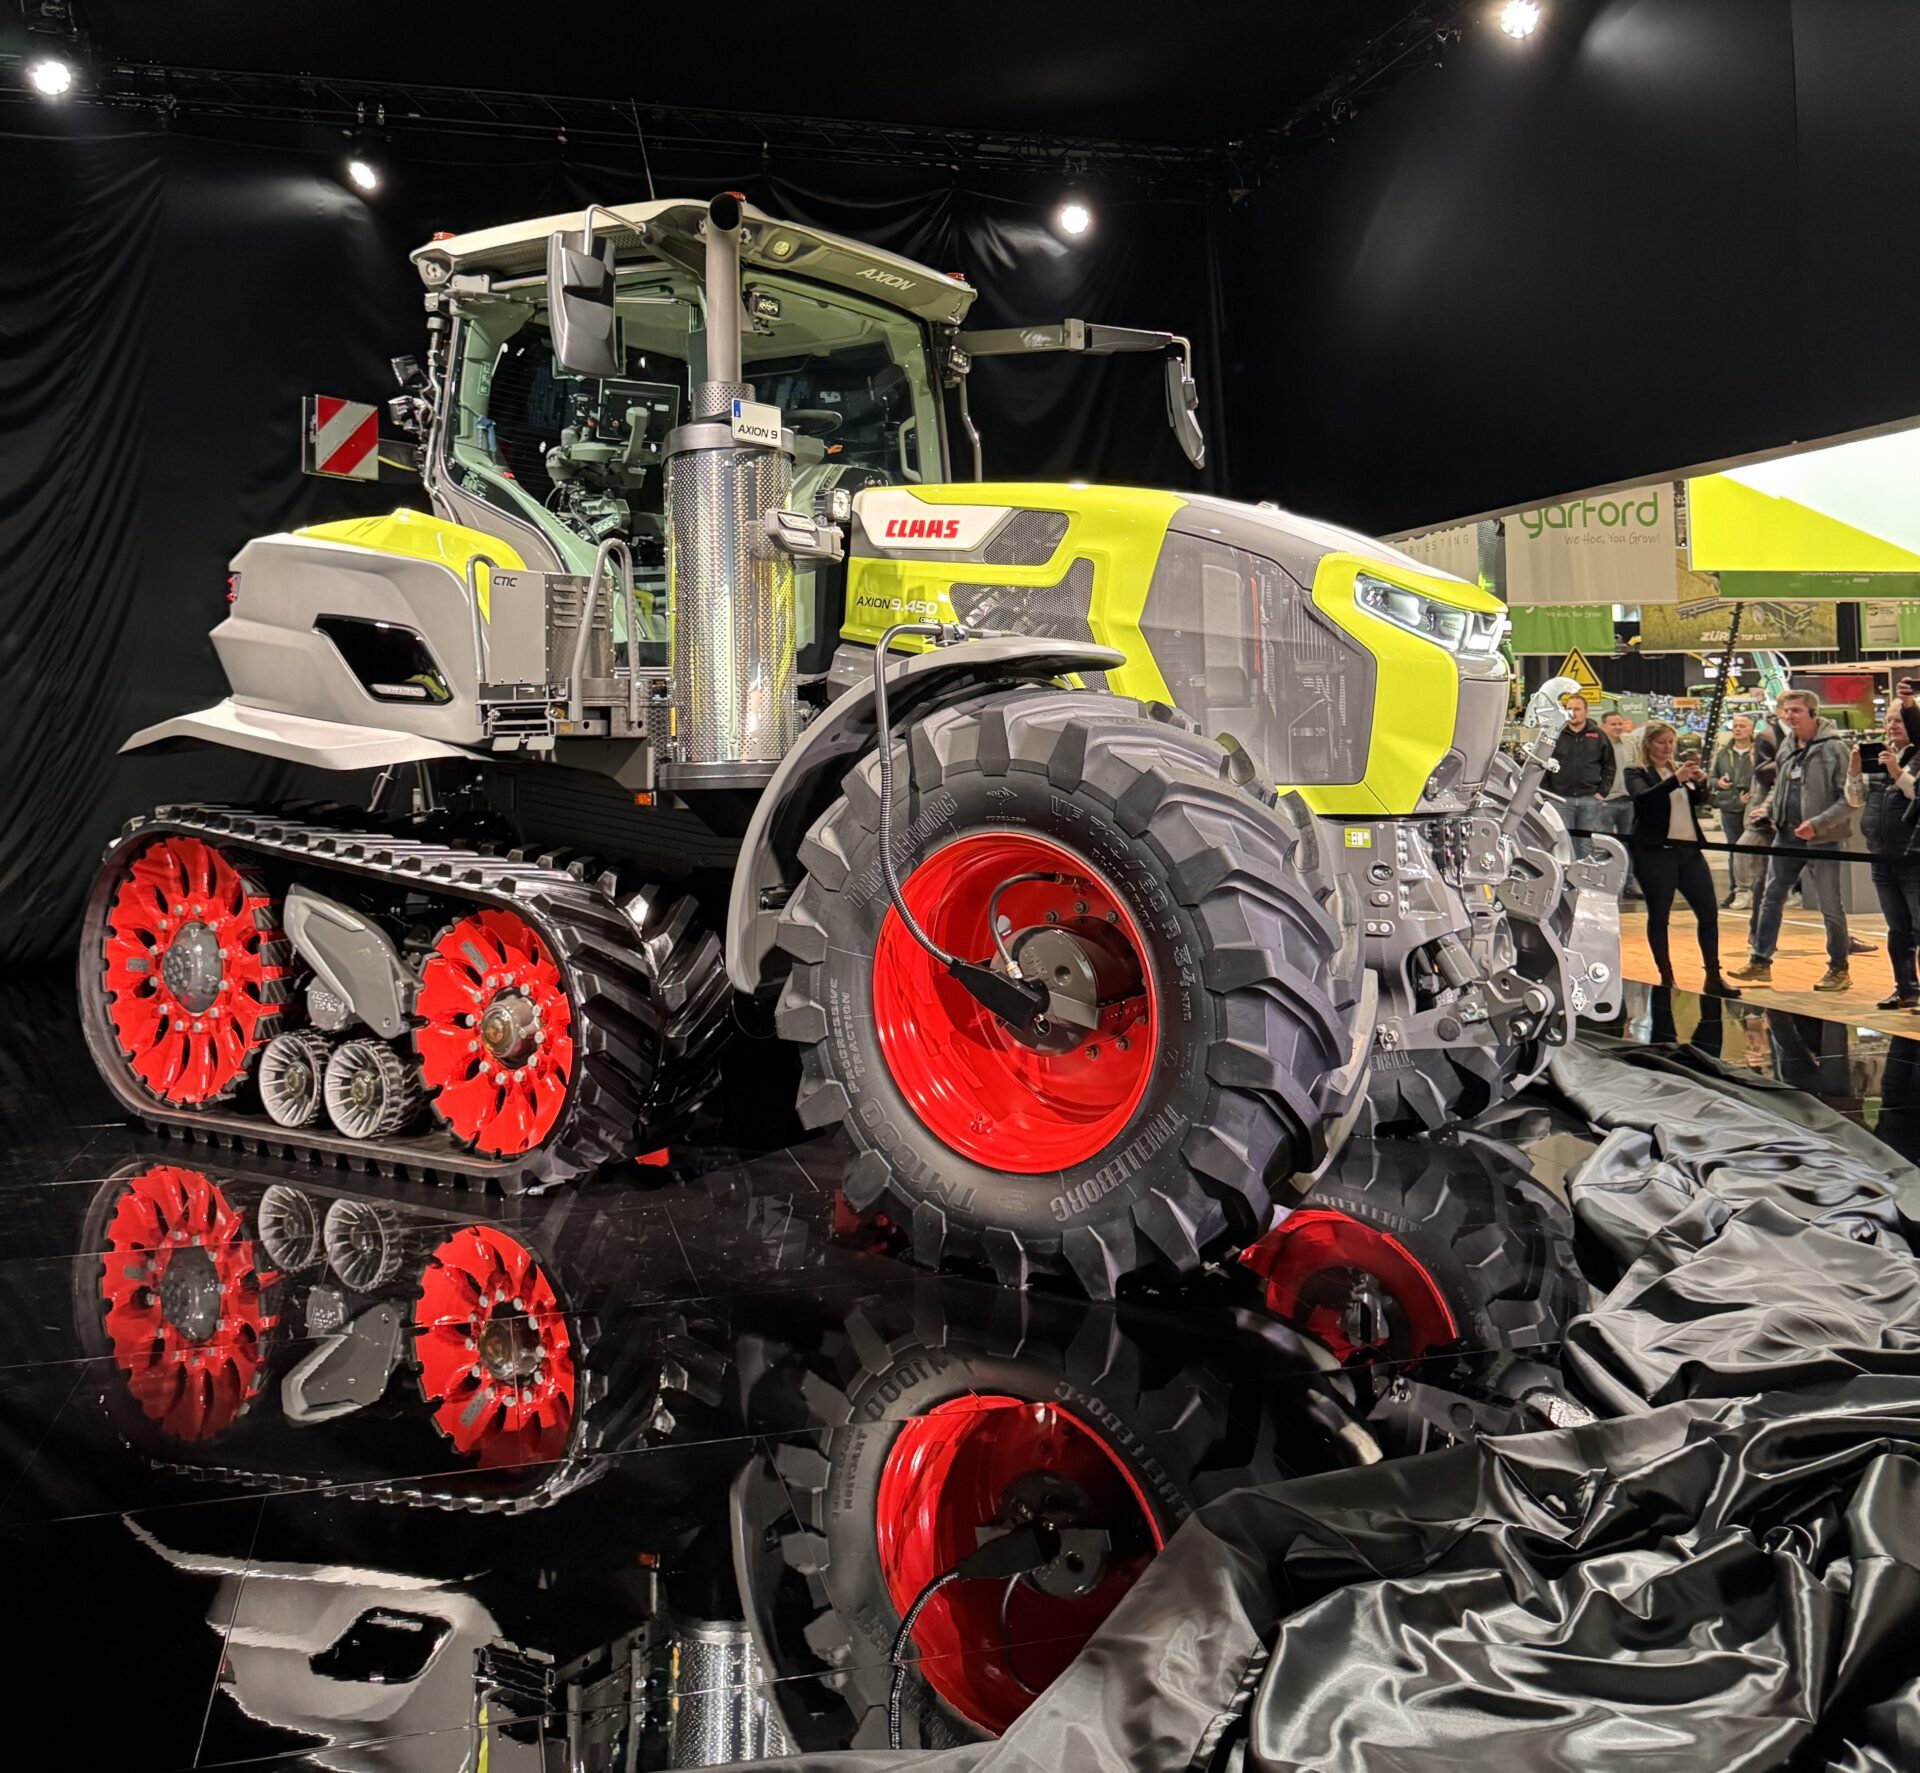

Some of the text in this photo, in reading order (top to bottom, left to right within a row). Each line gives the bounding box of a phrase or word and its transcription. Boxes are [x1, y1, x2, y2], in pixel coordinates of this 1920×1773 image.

[856, 268, 917, 291] AXION
[738, 424, 778, 439] AXION 9
[1518, 491, 1659, 540] garford
[885, 519, 960, 538] CLAAS
[1564, 535, 1584, 545] We
[1608, 533, 1627, 544] You
[493, 575, 518, 587] CTIC
[841, 992, 866, 1077] TRACTION
[859, 1096, 978, 1214] TM1000
[1050, 1103, 1188, 1222] TRELLEBORG
